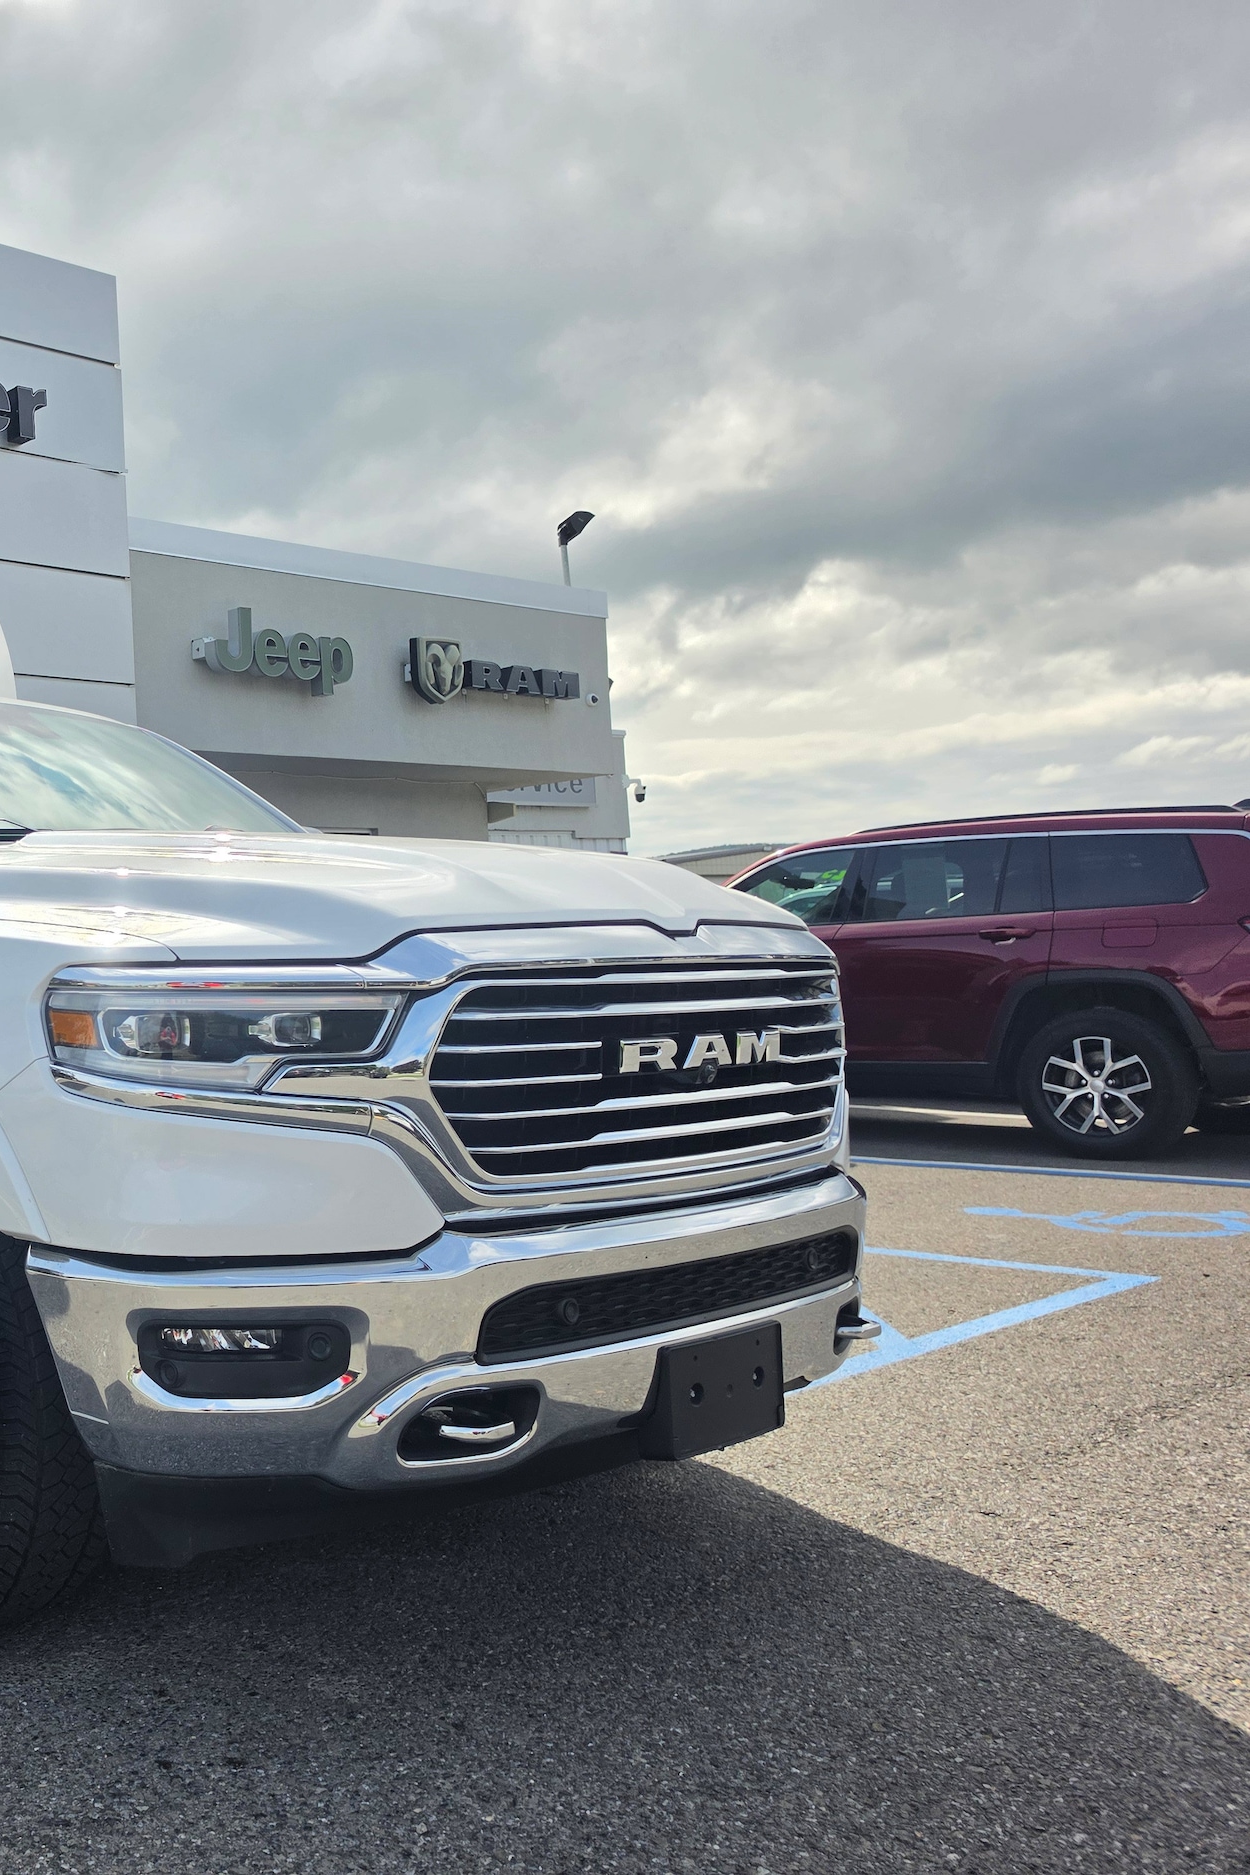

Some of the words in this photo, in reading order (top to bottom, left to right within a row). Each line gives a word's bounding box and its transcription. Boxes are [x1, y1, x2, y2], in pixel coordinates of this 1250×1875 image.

[205, 607, 353, 696] Jeep
[465, 659, 580, 700] RAM
[619, 1029, 781, 1074] RAM
